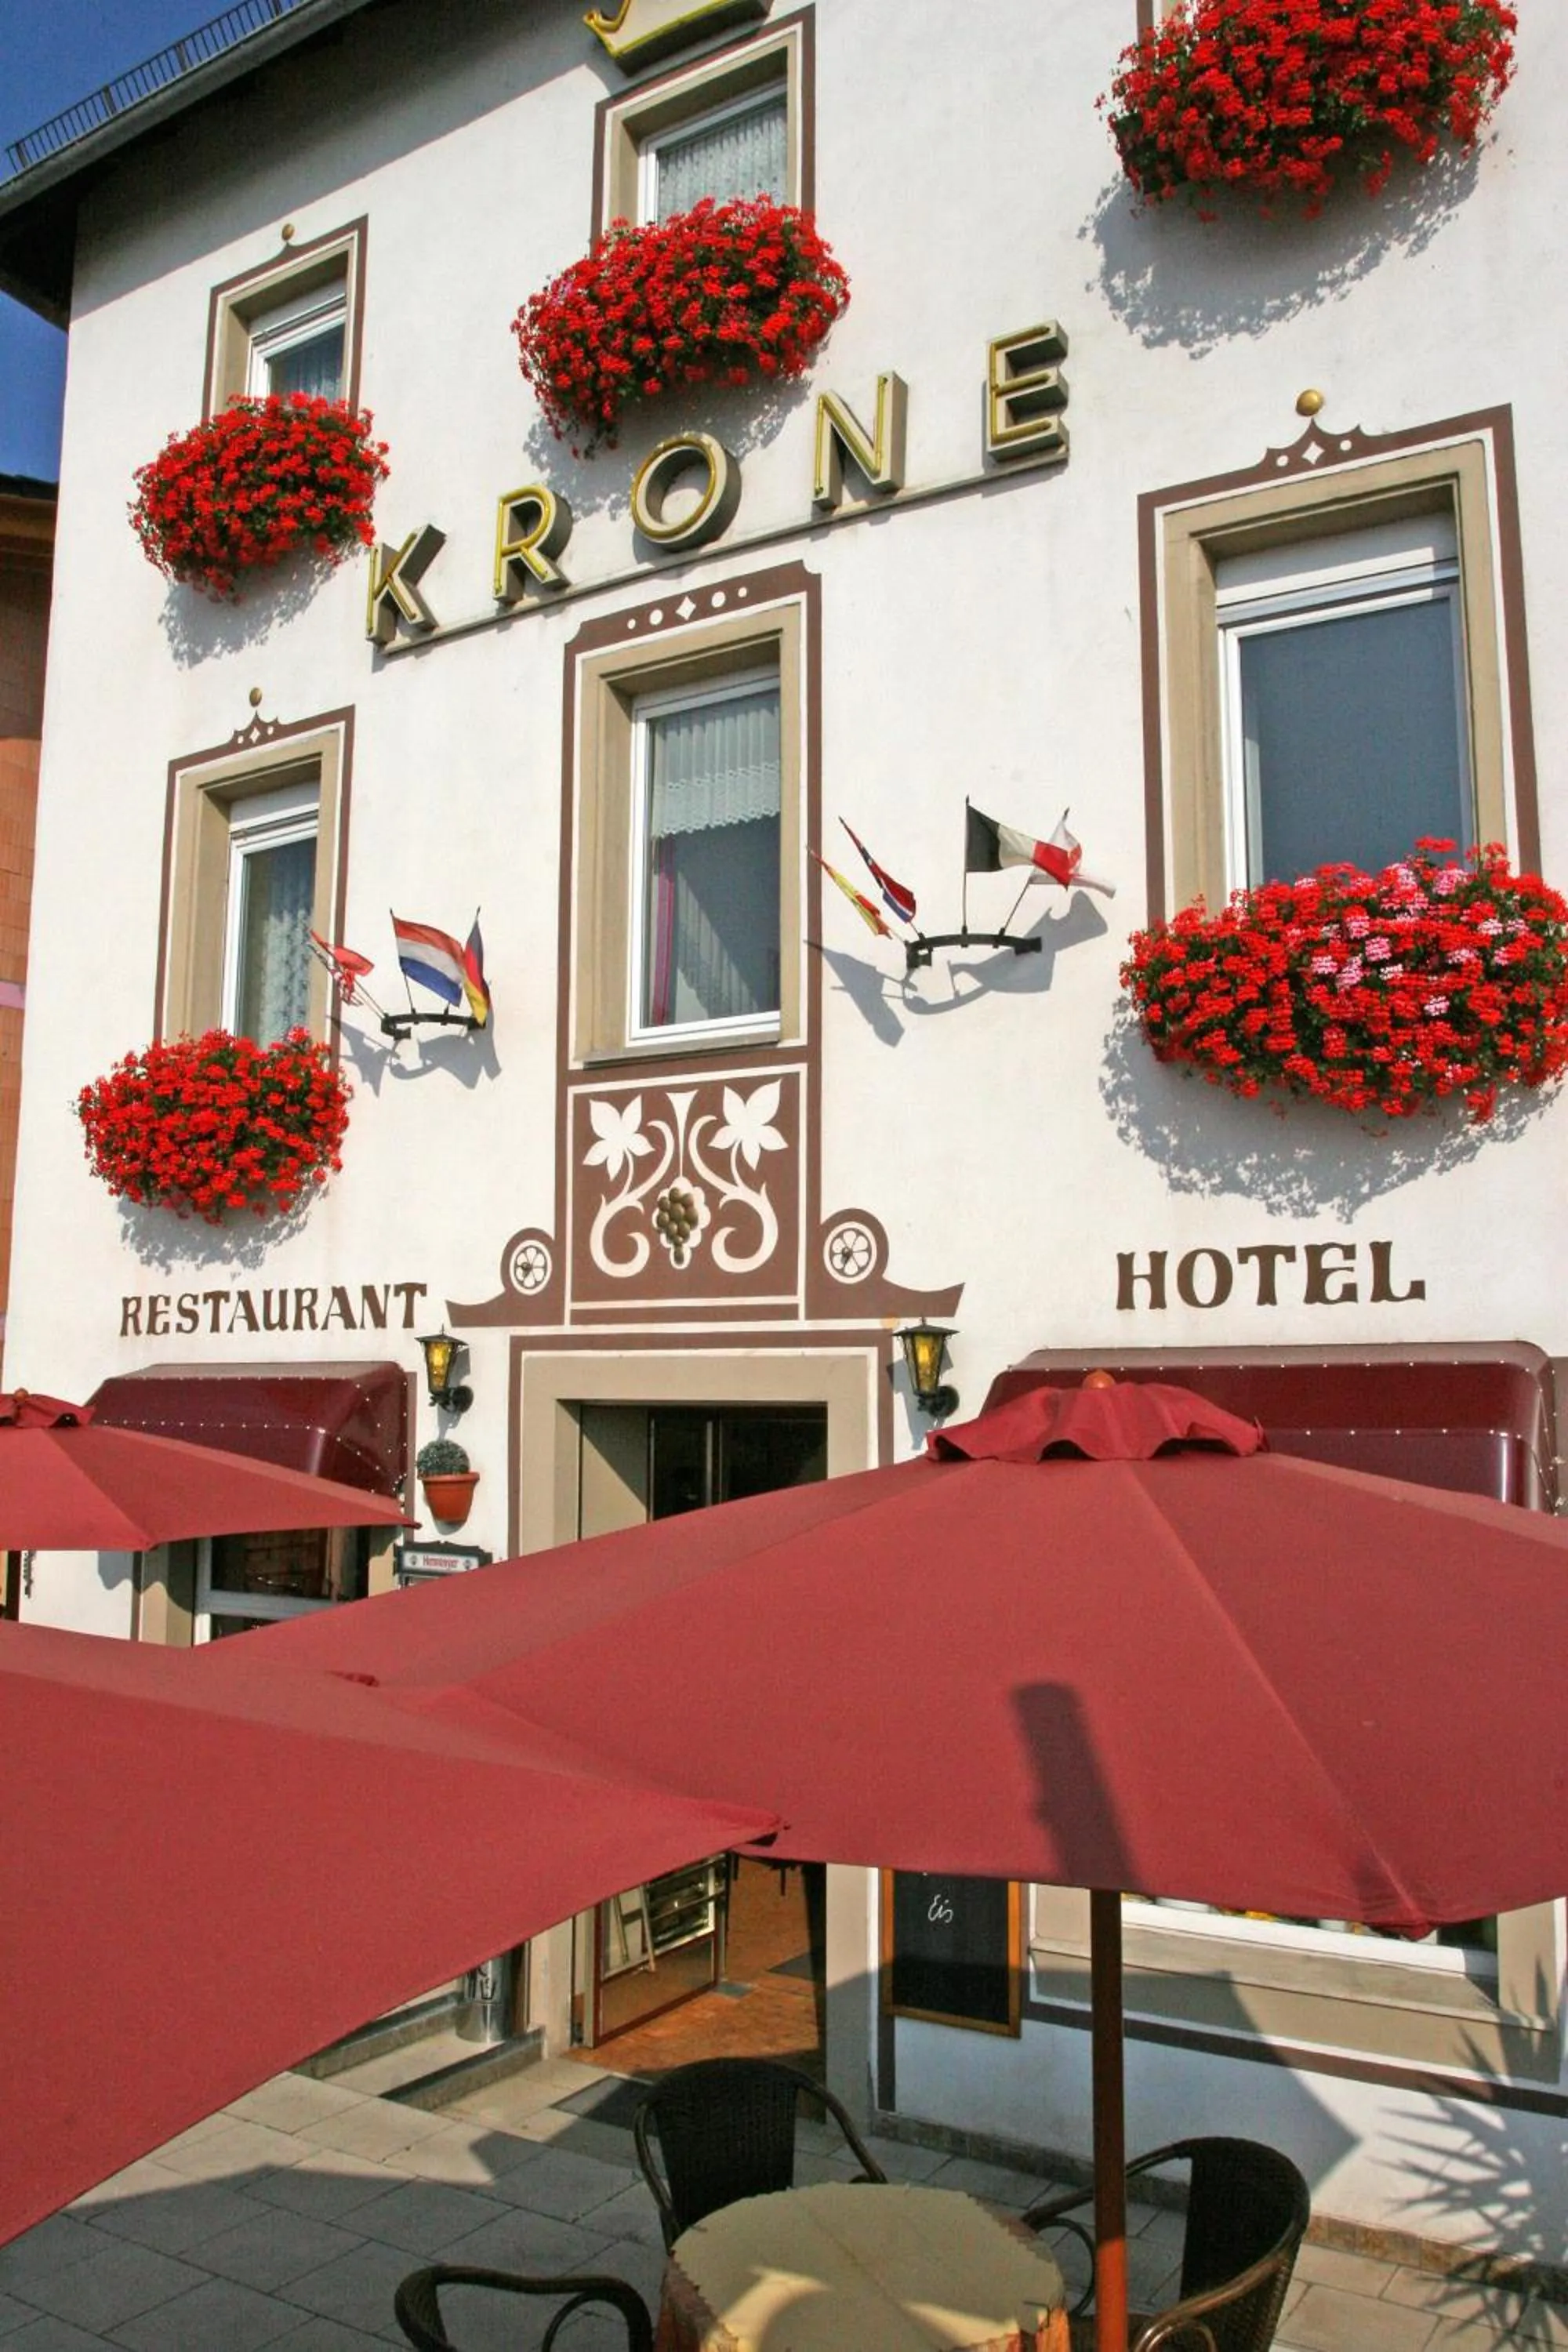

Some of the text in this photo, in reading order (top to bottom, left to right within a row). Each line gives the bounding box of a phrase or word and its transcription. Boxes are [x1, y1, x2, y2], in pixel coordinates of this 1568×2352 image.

[366, 318, 1069, 644] KRONE
[1116, 1241, 1426, 1310] HOTEL
[119, 1283, 427, 1337] RESTAURANT
[927, 1894, 954, 1923] Eis
